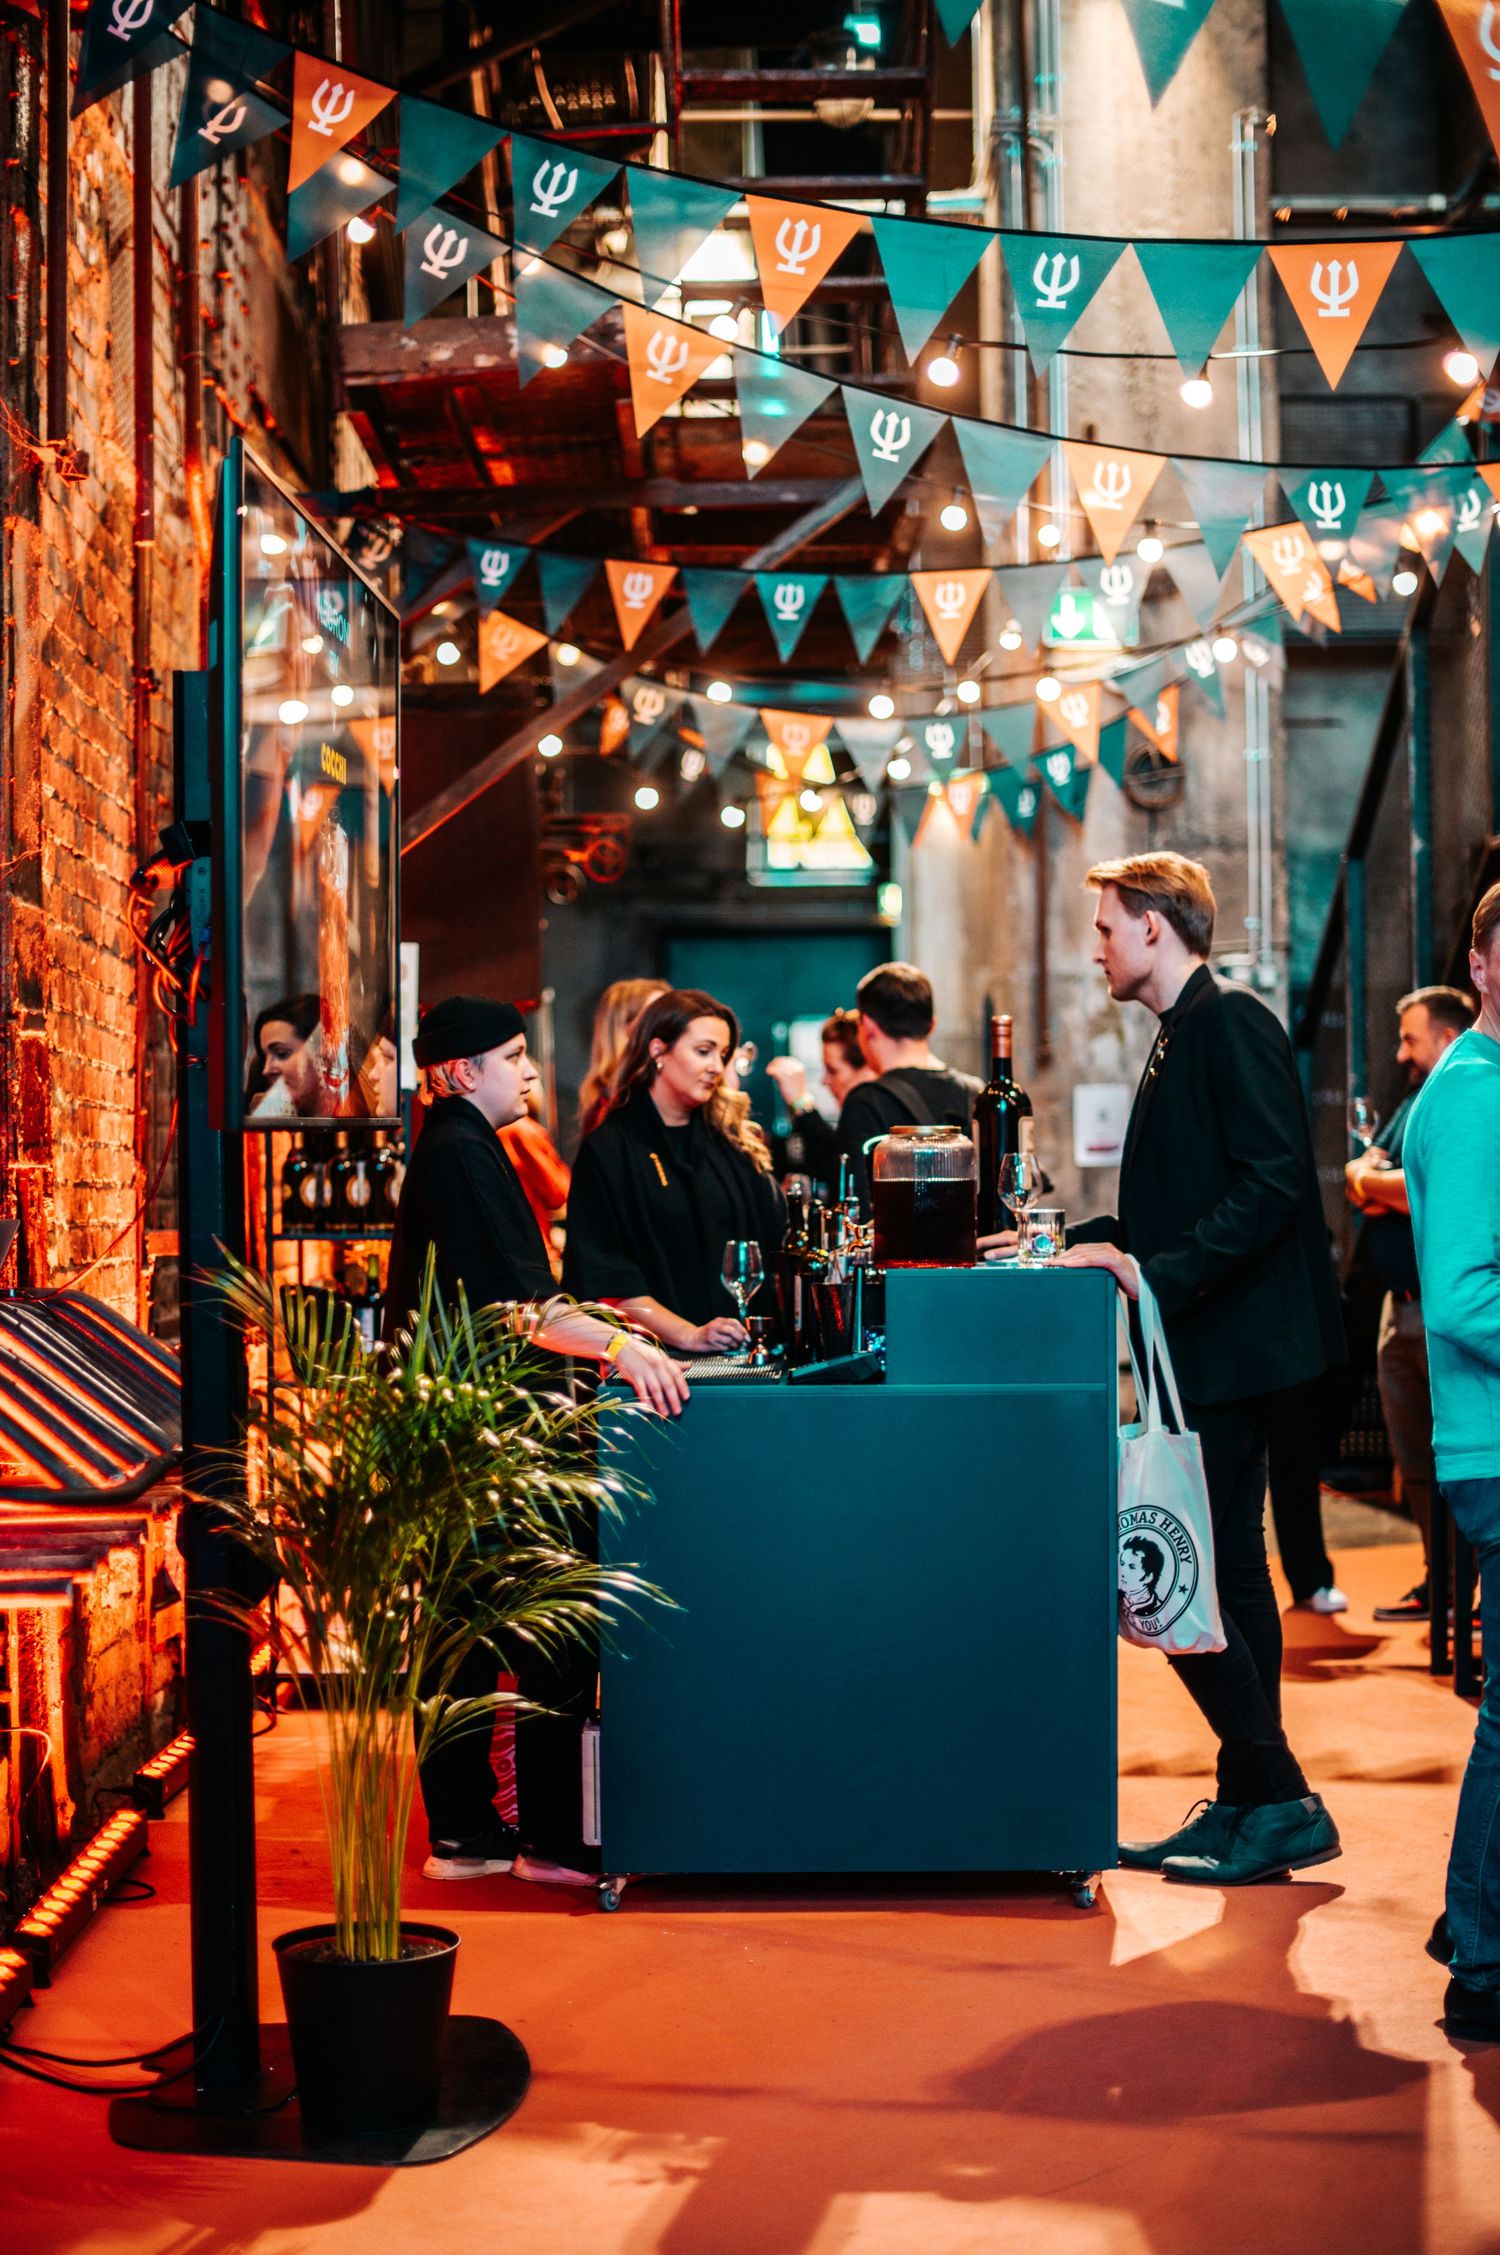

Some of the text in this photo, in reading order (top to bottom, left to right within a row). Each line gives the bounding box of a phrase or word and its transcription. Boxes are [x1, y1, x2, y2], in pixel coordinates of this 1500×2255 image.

[321, 742, 347, 785] COCCHI
[1119, 1511, 1192, 1564] OMAS HENRY
[1138, 1617, 1162, 1631] YOU!
